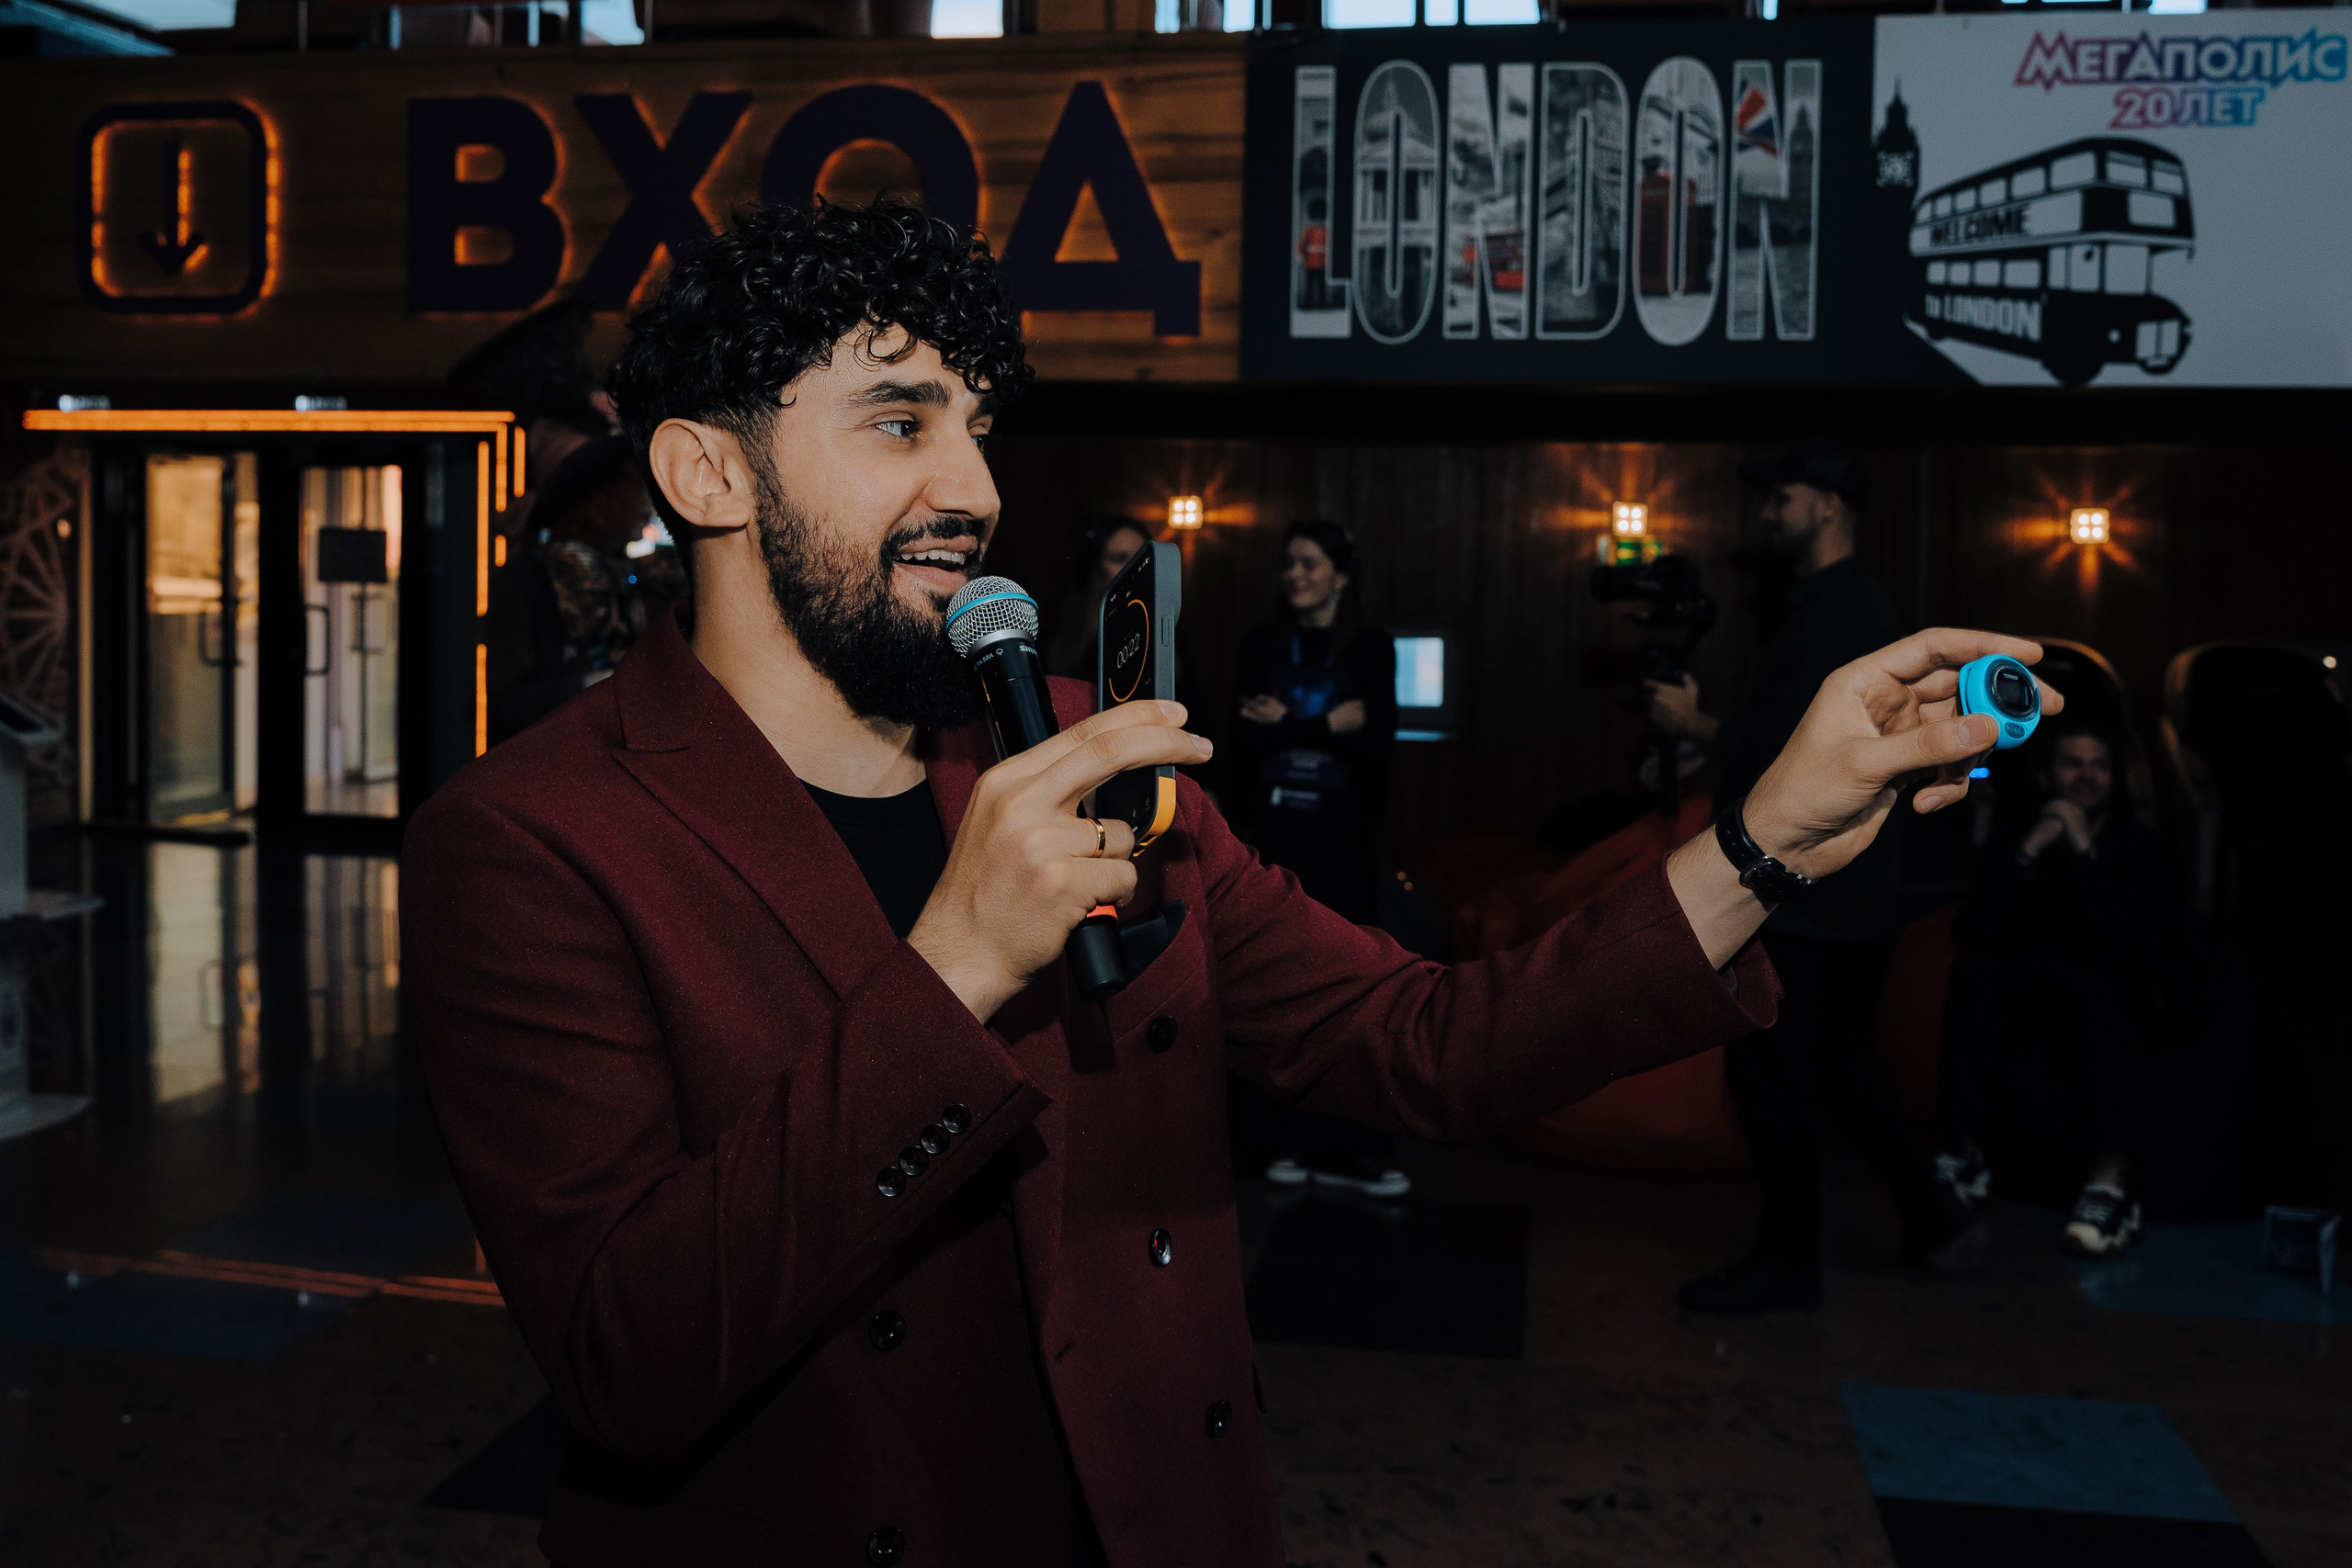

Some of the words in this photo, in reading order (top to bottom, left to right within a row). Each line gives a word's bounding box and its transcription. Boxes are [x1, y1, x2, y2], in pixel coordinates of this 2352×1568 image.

[2013, 28, 2347, 91] МЕГАПОЛИС
[1289, 55, 1824, 346] LONDON
[1930, 207, 2027, 245] WELCOME
[1943, 292, 2042, 343] LONDON
[1116, 633, 1140, 669] 00:22
